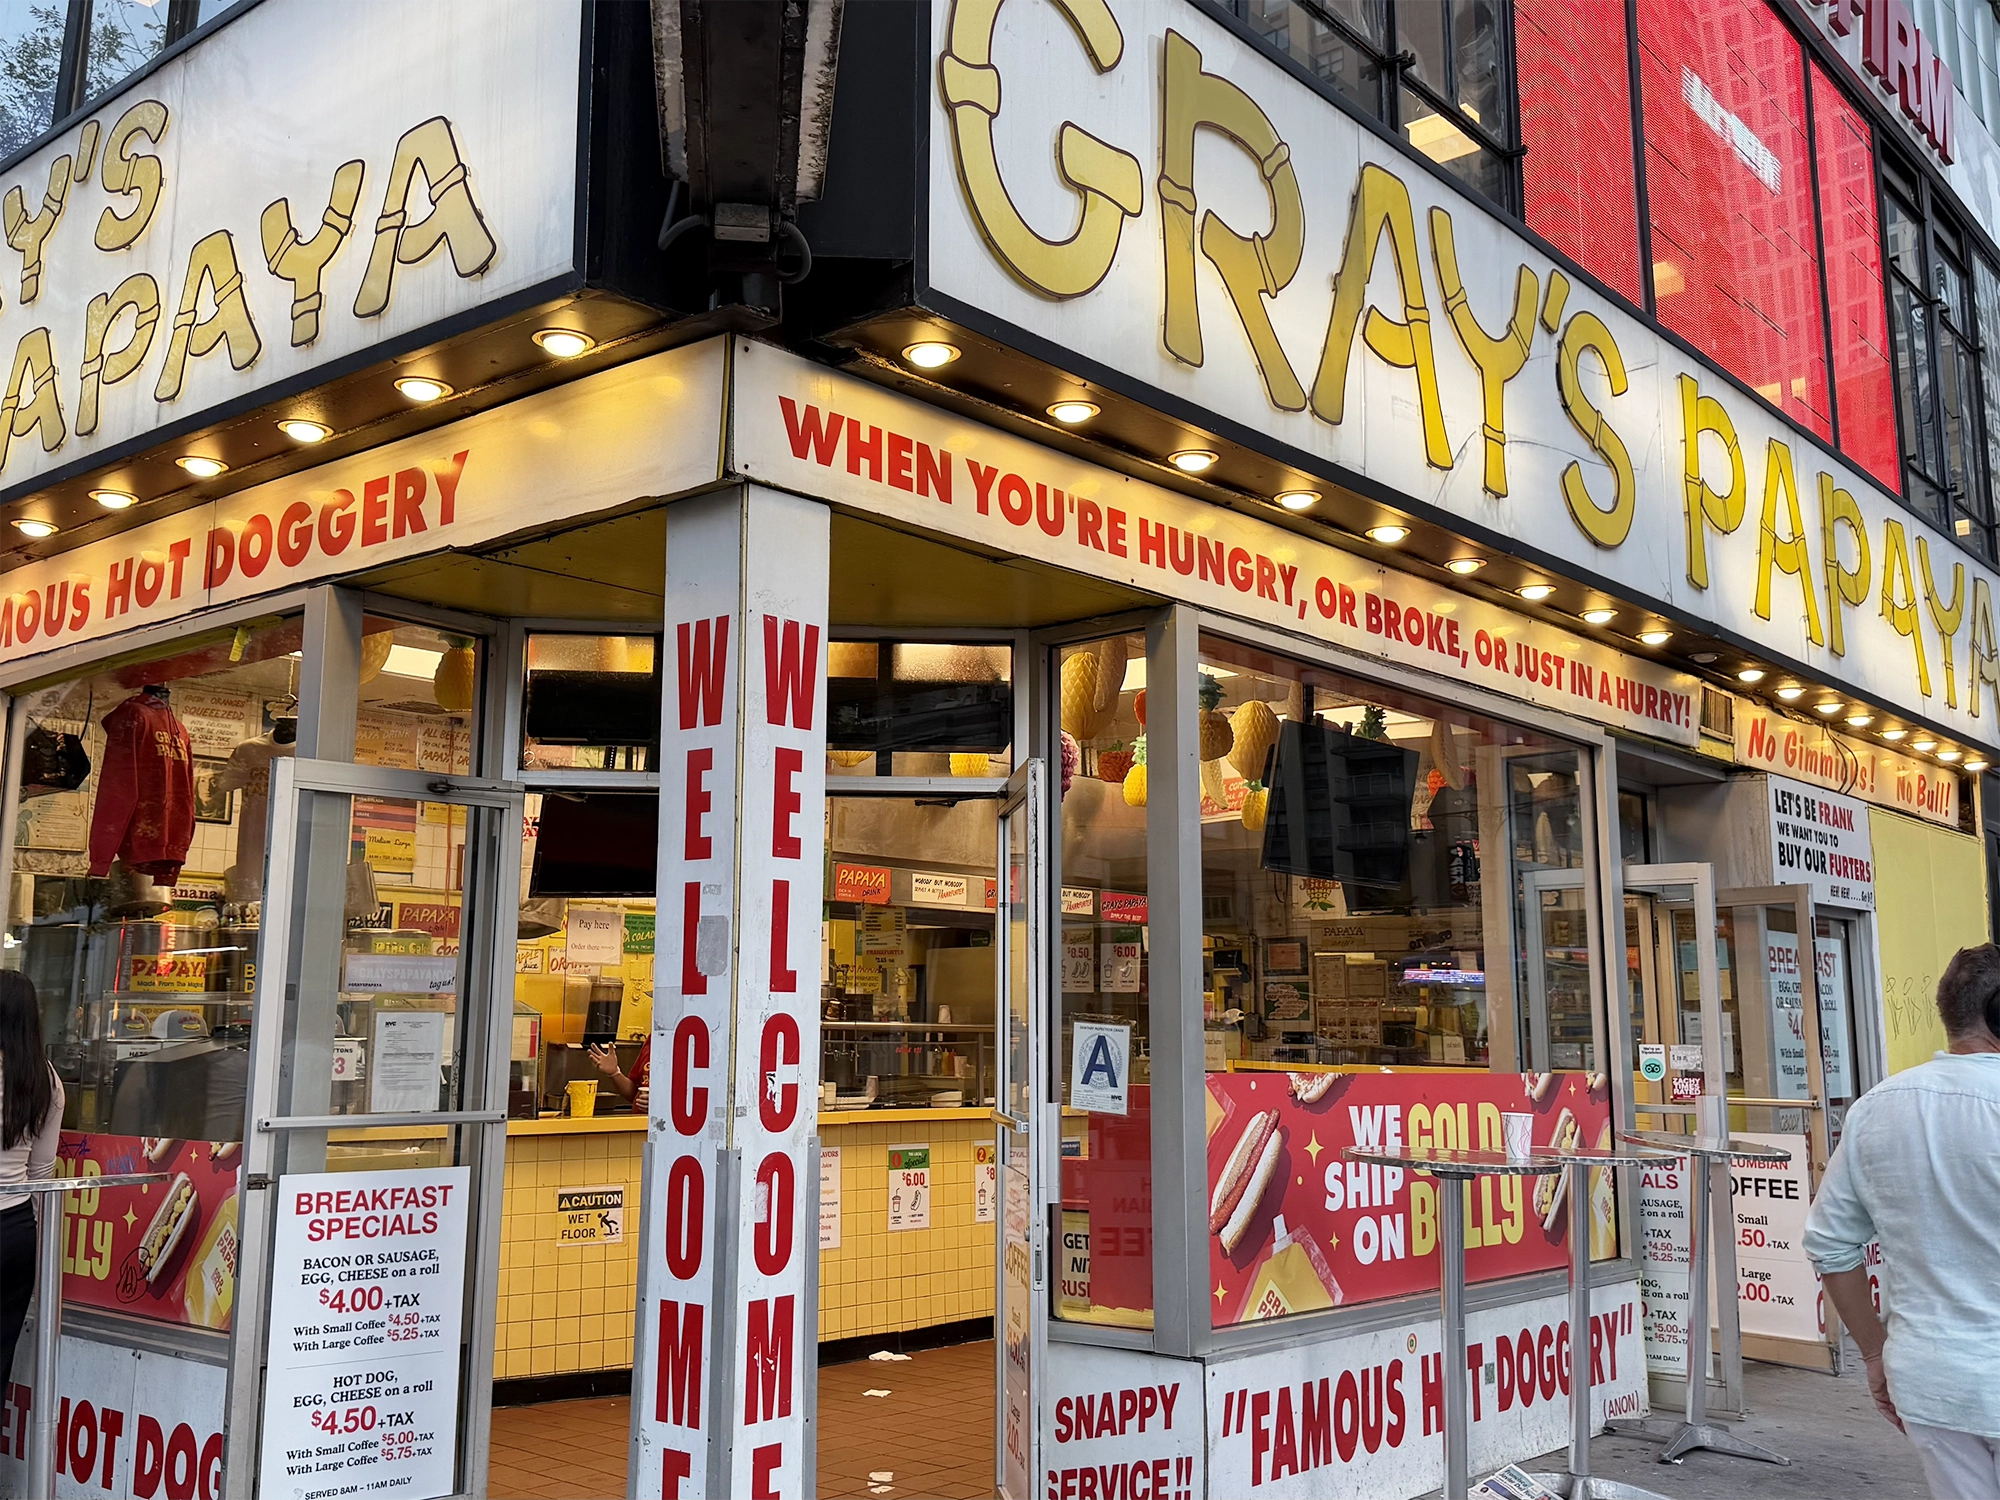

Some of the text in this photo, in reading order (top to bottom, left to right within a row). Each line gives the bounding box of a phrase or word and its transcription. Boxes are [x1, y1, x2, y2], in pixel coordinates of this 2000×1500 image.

[2, 100, 169, 305] Y'S
[940, 0, 1634, 548] GRAY'S
[105, 537, 191, 620] HOT
[203, 449, 470, 590] DOGGERY
[1679, 372, 2000, 718] PAPAYA
[777, 395, 1692, 730] WHEN YOU'RE HUNGRY, OR BROKE, OR JUST IN A HURRY!
[182, 705, 245, 720] SQUEEEZEDD
[210, 697, 246, 708] ORANGES
[423, 727, 438, 739] ALL
[1748, 717, 1776, 762] No
[1917, 773, 1951, 817] Bull!
[1774, 787, 1855, 832] LET'S BE FRANK
[1777, 820, 1839, 848] WE WANT YOU TO
[1778, 841, 1872, 883] BUY OUR FURTERS
[839, 869, 886, 888] PAPAYA
[862, 887, 881, 897] DRINK
[1101, 896, 1147, 912] GRAY'S PAPAYA
[401, 907, 456, 924] PAPAYA
[579, 918, 594, 931] Pay
[594, 918, 610, 930] here
[1323, 927, 1364, 937] PAPAYA
[570, 942, 586, 950] Order
[1067, 946, 1089, 959] $8.50
[1113, 945, 1137, 958] $6.00
[132, 958, 206, 978] PAPAYA
[1081, 1034, 1118, 1088] A
[1348, 1104, 1401, 1147] WE
[902, 1171, 925, 1187] $6.00
[1325, 1160, 1404, 1212] SHIP
[295, 1184, 454, 1216] BREAKFAST
[571, 1192, 623, 1207] CAUTION
[567, 1212, 591, 1225] WET
[1668, 1210, 1684, 1219] roll
[1737, 1213, 1769, 1226] Small
[307, 1211, 438, 1242] SPECIALS
[561, 1227, 596, 1240] FLOOR
[1644, 1229, 1672, 1239] +TAX
[1353, 1212, 1405, 1265] ON
[1648, 1241, 1673, 1251] $4.50
[1766, 1240, 1790, 1250] +TAX
[303, 1249, 440, 1270] BACON OR SAUSAGE,
[1648, 1251, 1673, 1262] $5.25
[301, 1263, 440, 1285] EGG, CHEESE on a roll
[1741, 1267, 1772, 1281] Large
[319, 1285, 421, 1314] $4.00 +TAX
[1673, 1291, 1689, 1300] roll
[1771, 1294, 1795, 1306] +TAX
[293, 1311, 441, 1337] With Small Coffee $4.50 +TAX
[1649, 1310, 1677, 1321] +TAX
[1653, 1322, 1678, 1334] $5.00
[292, 1326, 440, 1352] With Large Coffee $5.25 +TAX
[1654, 1333, 1678, 1344] $5.75
[333, 1370, 398, 1388] HOT DOG,
[293, 1380, 433, 1408] EGG, CHEESE on a roll
[1222, 1303, 1633, 1487] "FAMOUS HT DOGGRY"
[1054, 1382, 1181, 1444] SNAPPY
[1603, 1390, 1640, 1420] (ANON)
[310, 1405, 415, 1436] $4.50 +TAX
[286, 1430, 435, 1460] With Small Coffee $5.00 +TAX
[286, 1445, 433, 1476] With Large Coffee $5.75 +TAX
[304, 1475, 413, 1500] SERVED 8AM 11AM DAILY
[1046, 1456, 1193, 1500] SERVICE!!
